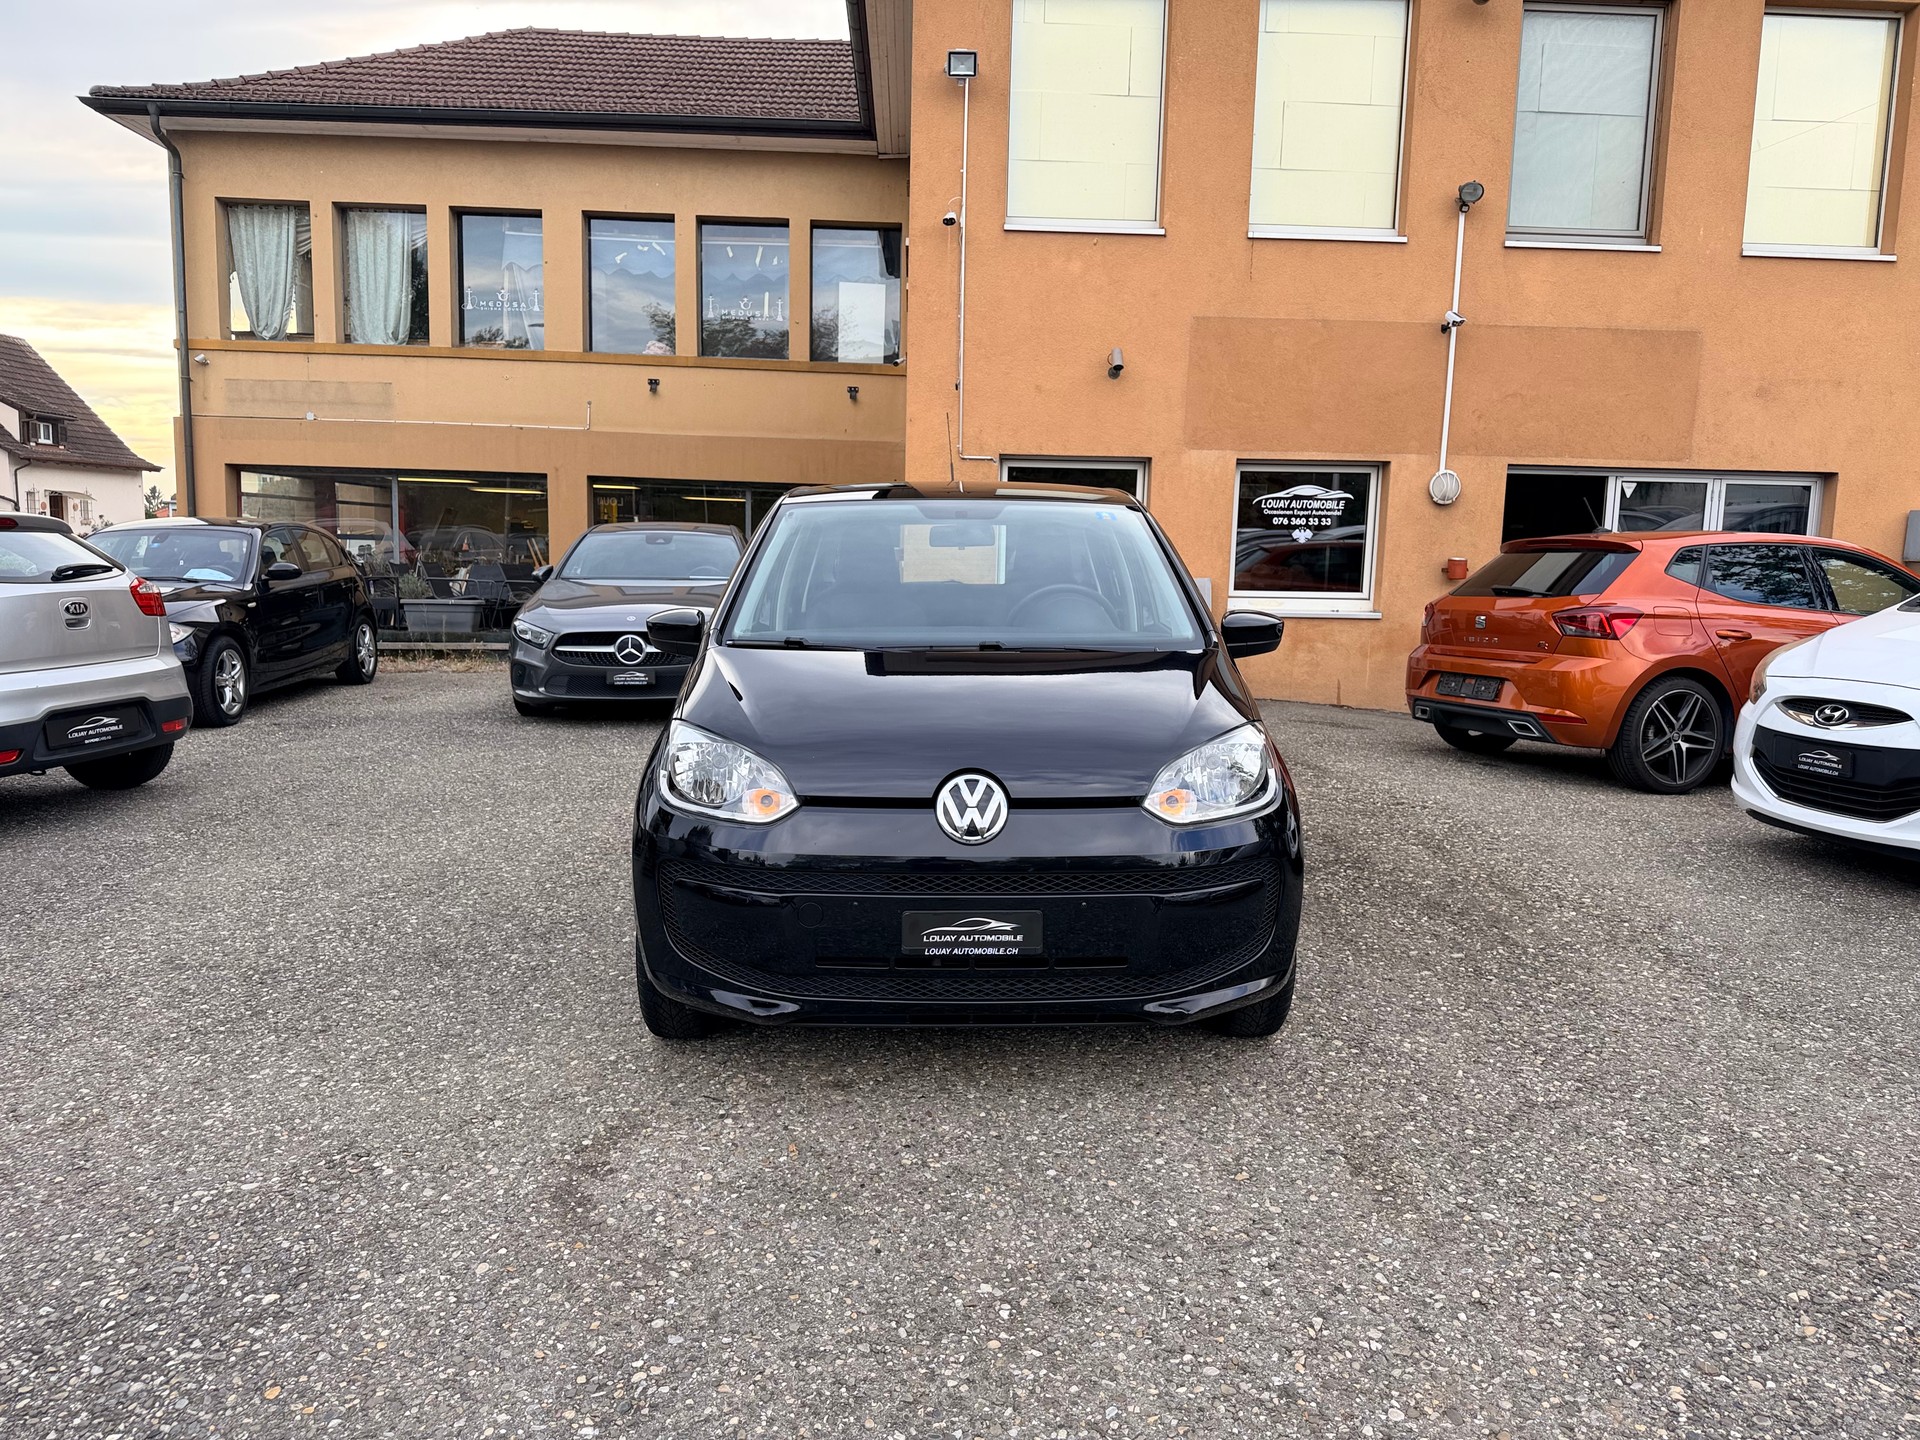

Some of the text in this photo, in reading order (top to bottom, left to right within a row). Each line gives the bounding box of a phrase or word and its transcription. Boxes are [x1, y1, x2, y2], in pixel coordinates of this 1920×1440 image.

[479, 300, 527, 308] MEDUSA
[1261, 499, 1345, 509] LOUAY AUTOMOBILE
[1272, 517, 1289, 525] 076
[1320, 518, 1331, 526] 33
[68, 603, 86, 614] KIA
[68, 724, 123, 739] LOUAY AUTOMOBILE
[1813, 759, 1842, 769] AUTOMOBILE
[923, 934, 1023, 942] LOUAY AUTOMOBILE
[924, 947, 1018, 955] LOUAY AUTOMOBILE.CH
